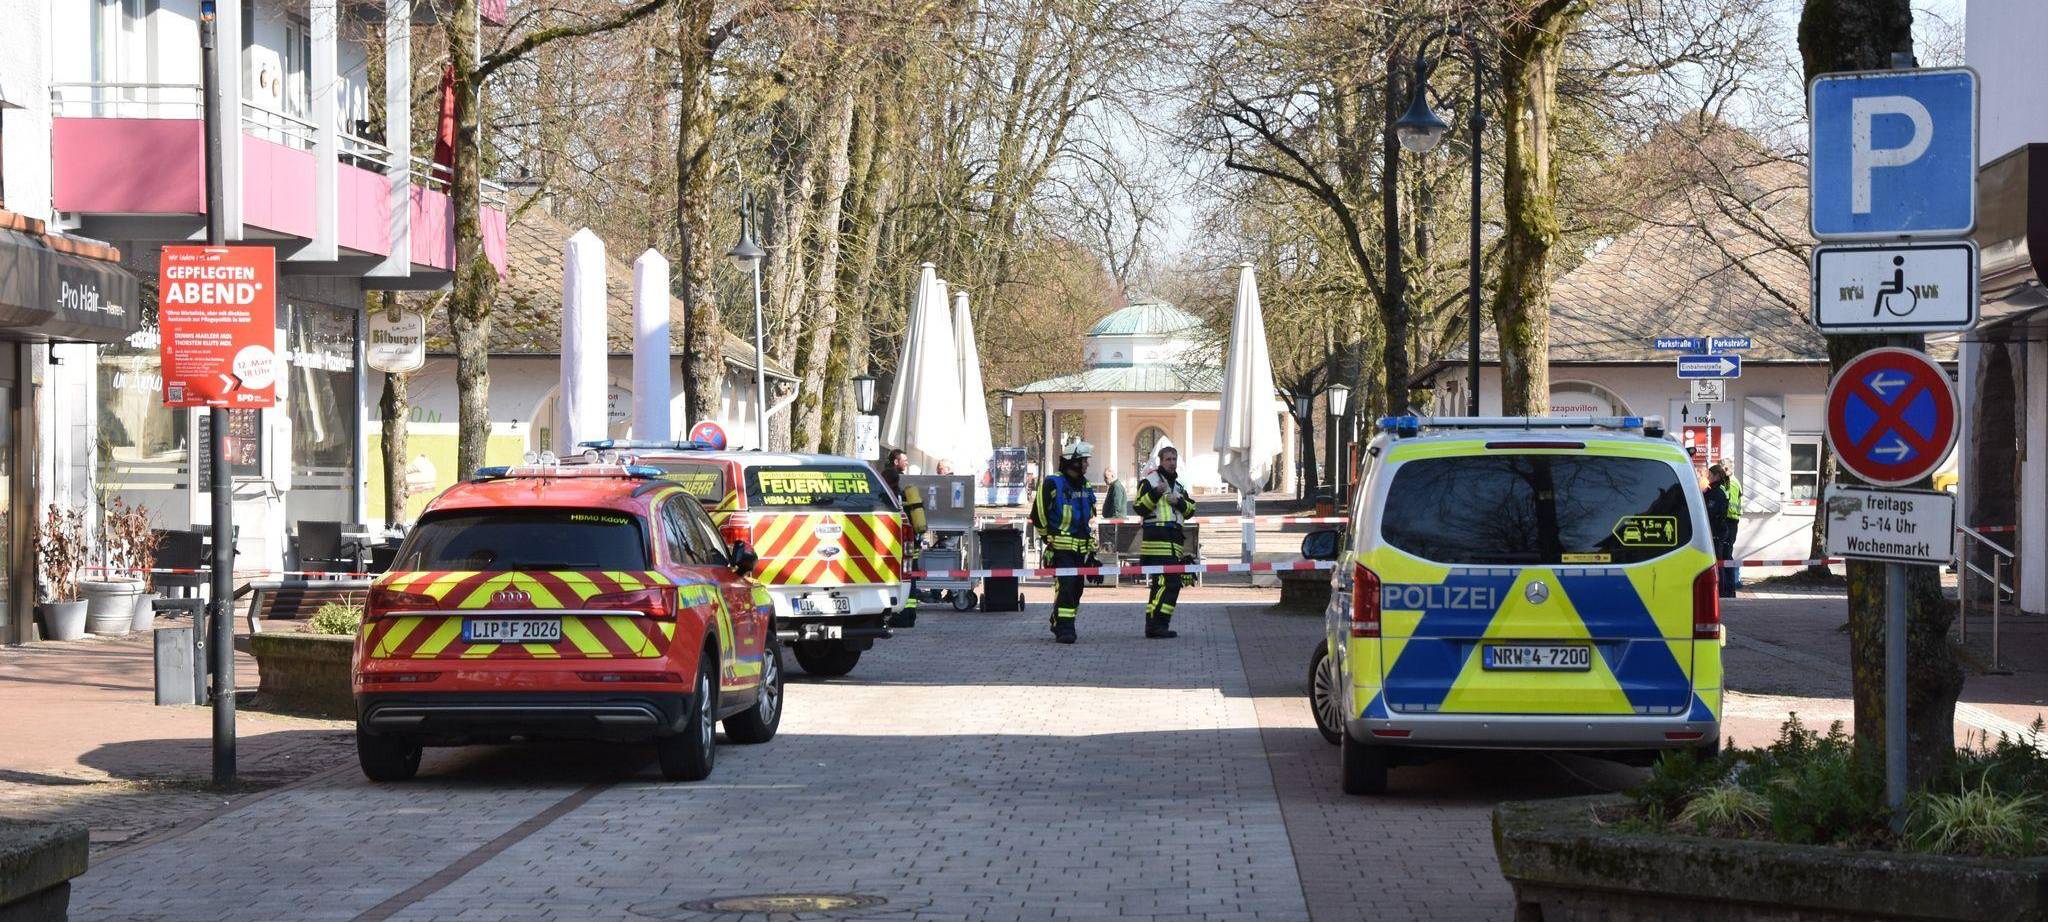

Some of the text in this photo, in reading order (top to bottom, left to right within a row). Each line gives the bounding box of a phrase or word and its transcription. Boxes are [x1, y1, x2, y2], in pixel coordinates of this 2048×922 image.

[1852, 96, 1934, 214] P
[166, 265, 255, 280] GEPFLEGTEN
[61, 280, 99, 312] Pro Hair
[1657, 340, 1691, 348] Parkstraße
[1713, 339, 1748, 347] Parkstraße
[1551, 404, 1598, 413] zzapavillon
[760, 479, 870, 494] FEUERWEHR
[795, 495, 812, 505] MZF
[1867, 495, 1914, 515] freitags
[601, 515, 629, 525] KdoW
[1642, 520, 1654, 529] 1,5
[1896, 518, 1917, 534] Uhr
[1847, 536, 1930, 557] Wochenmarkt
[1384, 585, 1495, 610] POLIZEI
[473, 621, 558, 638] LIP F 2026
[1493, 648, 1588, 665] NRW 4-7200
